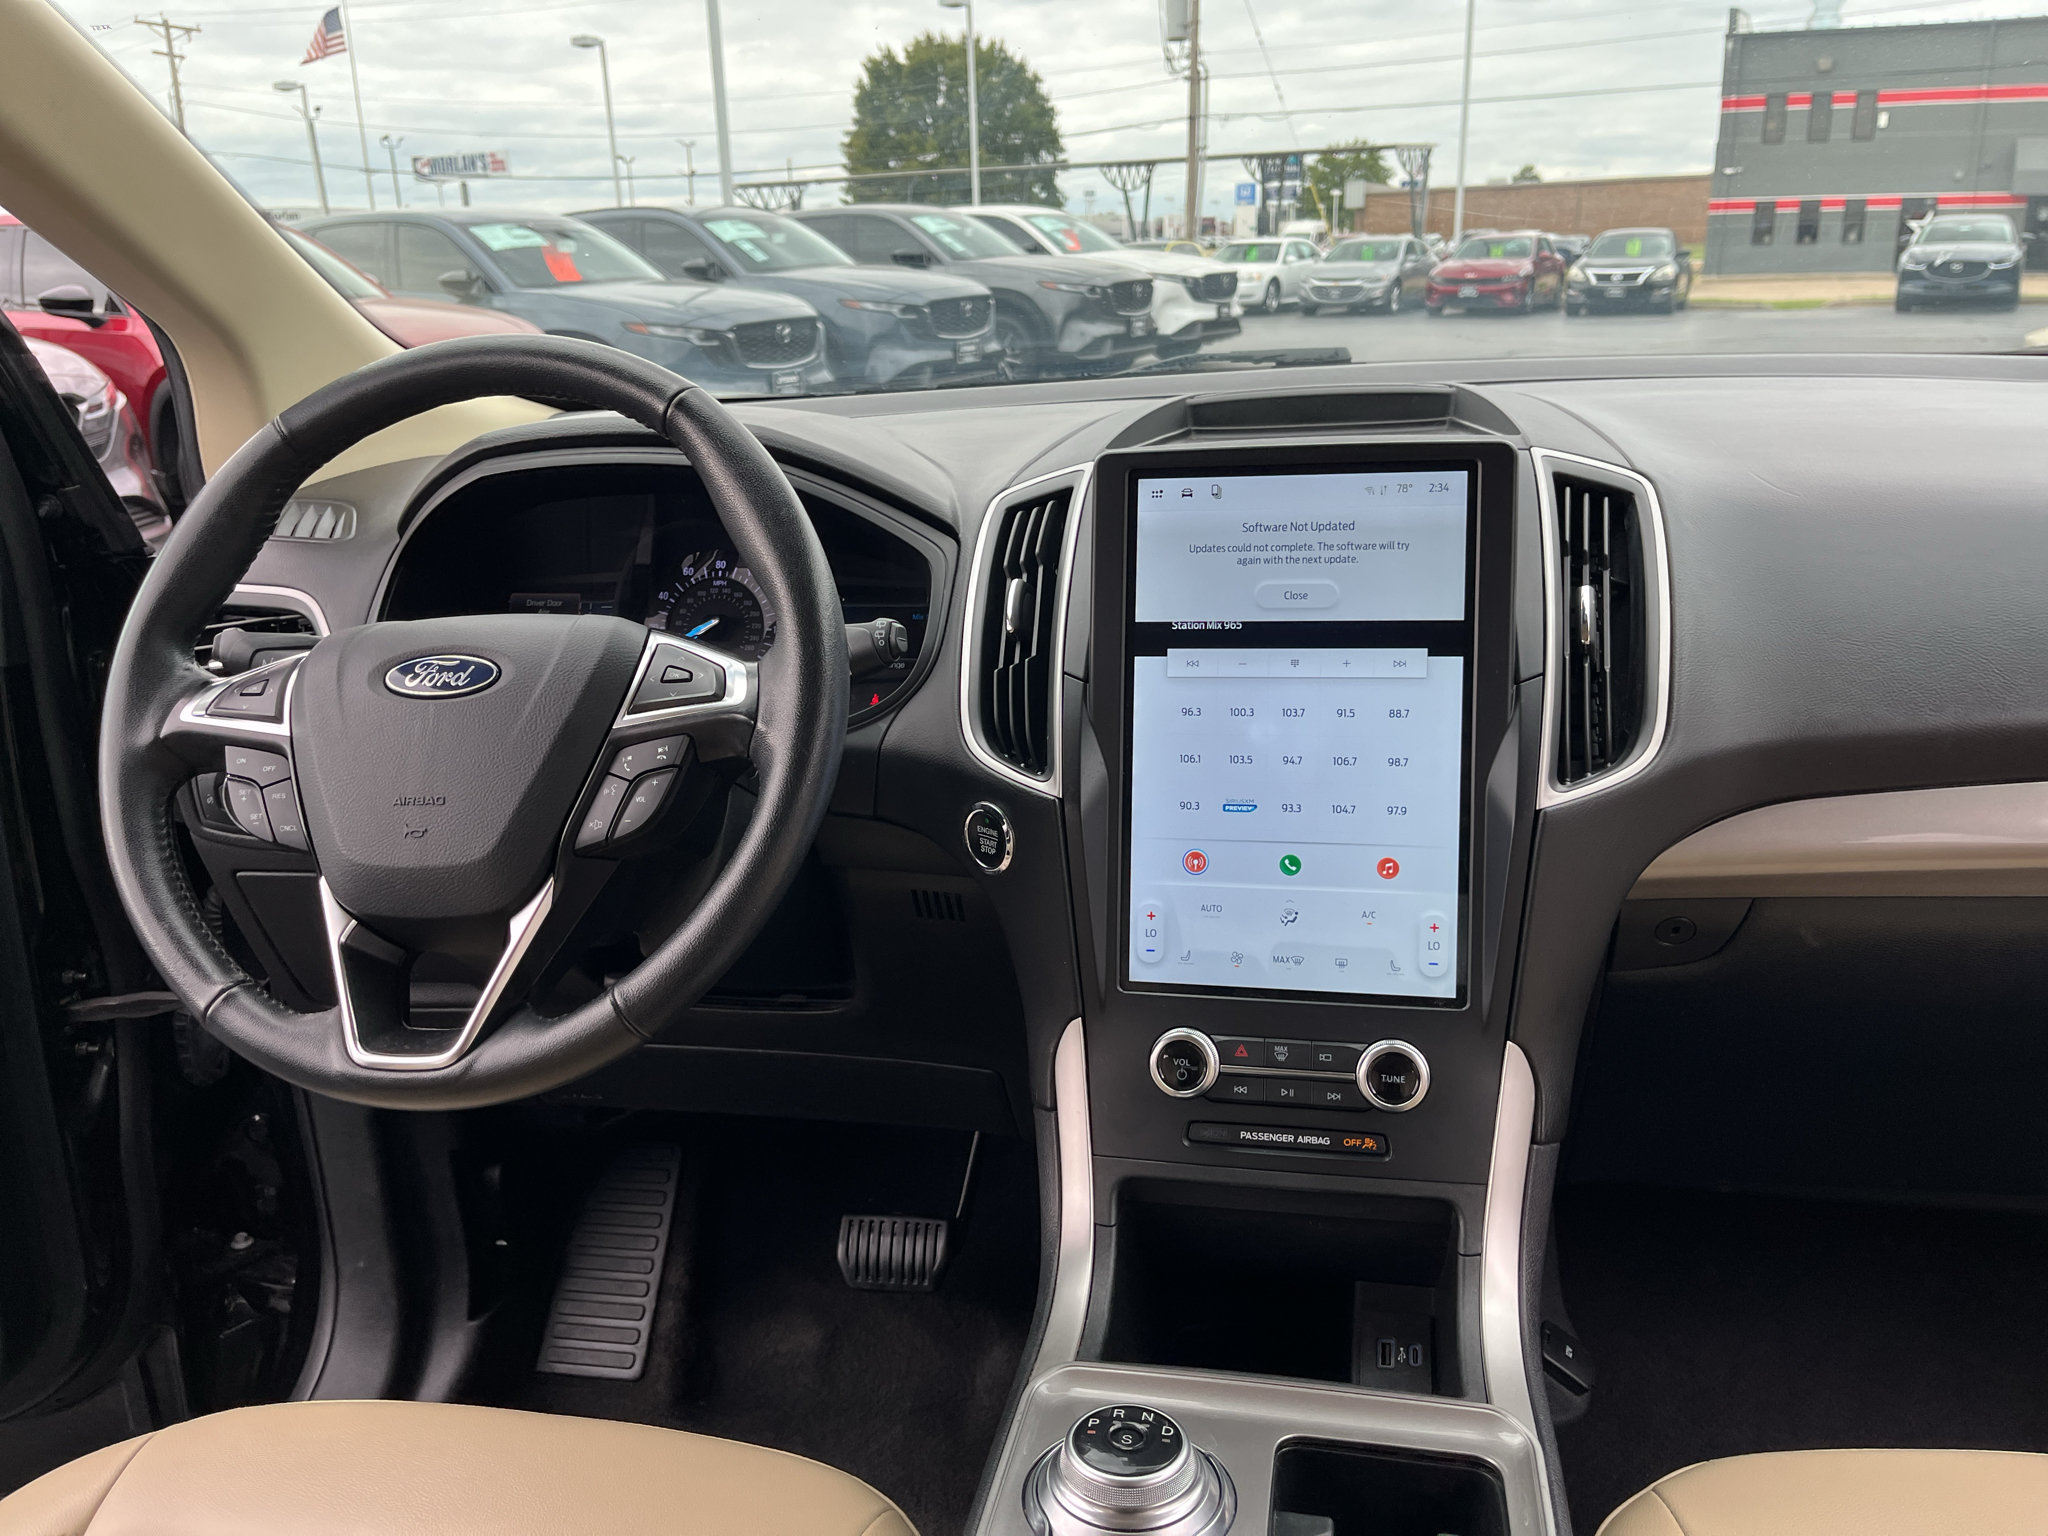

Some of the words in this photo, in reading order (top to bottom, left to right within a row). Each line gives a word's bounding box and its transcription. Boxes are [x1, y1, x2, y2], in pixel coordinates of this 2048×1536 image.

[1396, 483, 1413, 494] 78°
[1428, 482, 1449, 493] 2:34
[1241, 521, 1288, 533] Software
[1290, 521, 1308, 532] Not
[1310, 520, 1355, 534] Updated
[1189, 543, 1226, 555] Updates
[1227, 542, 1251, 553] could
[1253, 543, 1268, 553] not
[1270, 541, 1315, 554] complete.
[1317, 541, 1334, 552] The
[1336, 540, 1376, 551] software
[1378, 540, 1395, 550] will
[1397, 541, 1410, 552] try
[715, 560, 726, 569] 80
[1236, 556, 1260, 567] again
[1263, 555, 1284, 565] with
[1285, 555, 1300, 565] the
[1302, 555, 1322, 564] next
[1324, 554, 1359, 566] update.
[682, 567, 694, 576] 60
[658, 591, 669, 601] 40
[1283, 590, 1309, 601] Close
[526, 599, 545, 607] Driver
[546, 599, 562, 607] Door
[1171, 621, 1205, 630] Station
[1206, 621, 1223, 630] Mix
[1223, 621, 1243, 630] 965
[404, 660, 476, 688] Ford
[1181, 707, 1202, 717] 96.3
[1229, 707, 1255, 717] 100.3
[1281, 708, 1305, 718] 103.7
[1336, 709, 1355, 719] 91.5
[1388, 709, 1410, 719] 88.7
[1179, 754, 1201, 764] 106.1
[1228, 755, 1253, 765] 103.5
[1282, 756, 1303, 765] 94.7
[1332, 756, 1357, 766] 106.7
[1387, 757, 1409, 767] 98.7
[393, 796, 446, 806] AIRBAG
[1179, 800, 1200, 811] 90.3
[1281, 803, 1302, 813] 93.3
[1331, 804, 1356, 814] 104.7
[1386, 805, 1408, 816] 97.9
[977, 825, 998, 837] ENGINE
[979, 838, 997, 849] START
[980, 845, 996, 855] STOP
[1200, 903, 1223, 913] AUTO
[1361, 910, 1377, 920] A/C
[1145, 928, 1157, 938] LO
[1427, 941, 1441, 951] LO
[1272, 955, 1291, 965] MAX
[1173, 1058, 1191, 1067] VOL
[1381, 1074, 1406, 1084] TUNE
[1240, 1131, 1295, 1144] PASSENGER
[1296, 1135, 1331, 1146] AIRBAG
[1343, 1138, 1362, 1147] OFF
[1112, 1408, 1125, 1419] R
[1141, 1412, 1154, 1422] N
[1087, 1418, 1100, 1428] P
[1161, 1426, 1174, 1436] D
[1121, 1435, 1133, 1445] S
